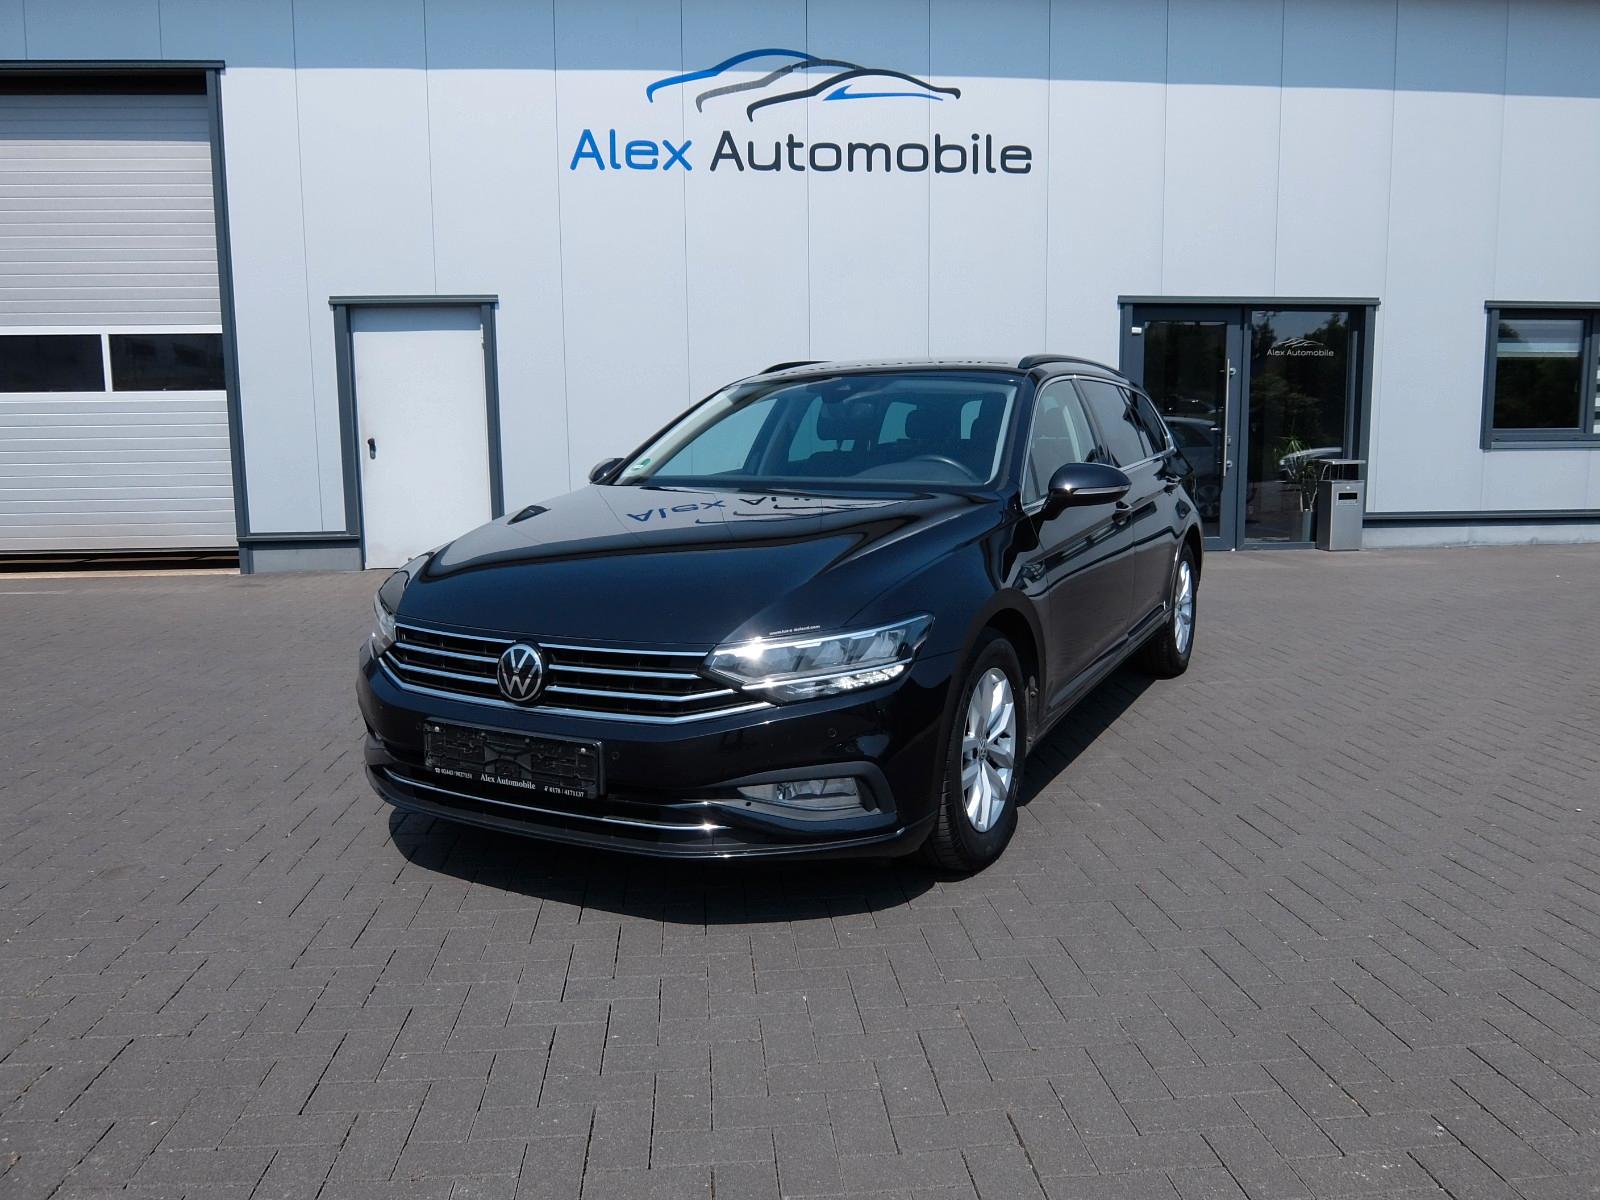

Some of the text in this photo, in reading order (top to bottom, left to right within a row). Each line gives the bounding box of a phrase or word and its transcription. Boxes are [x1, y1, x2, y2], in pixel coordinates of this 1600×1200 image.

[570, 128, 1032, 174] Alex Automobile
[1266, 348, 1335, 357] Alex Automobile
[499, 644, 542, 700] VW
[480, 773, 496, 784] Alex
[496, 775, 536, 791] Automobile
